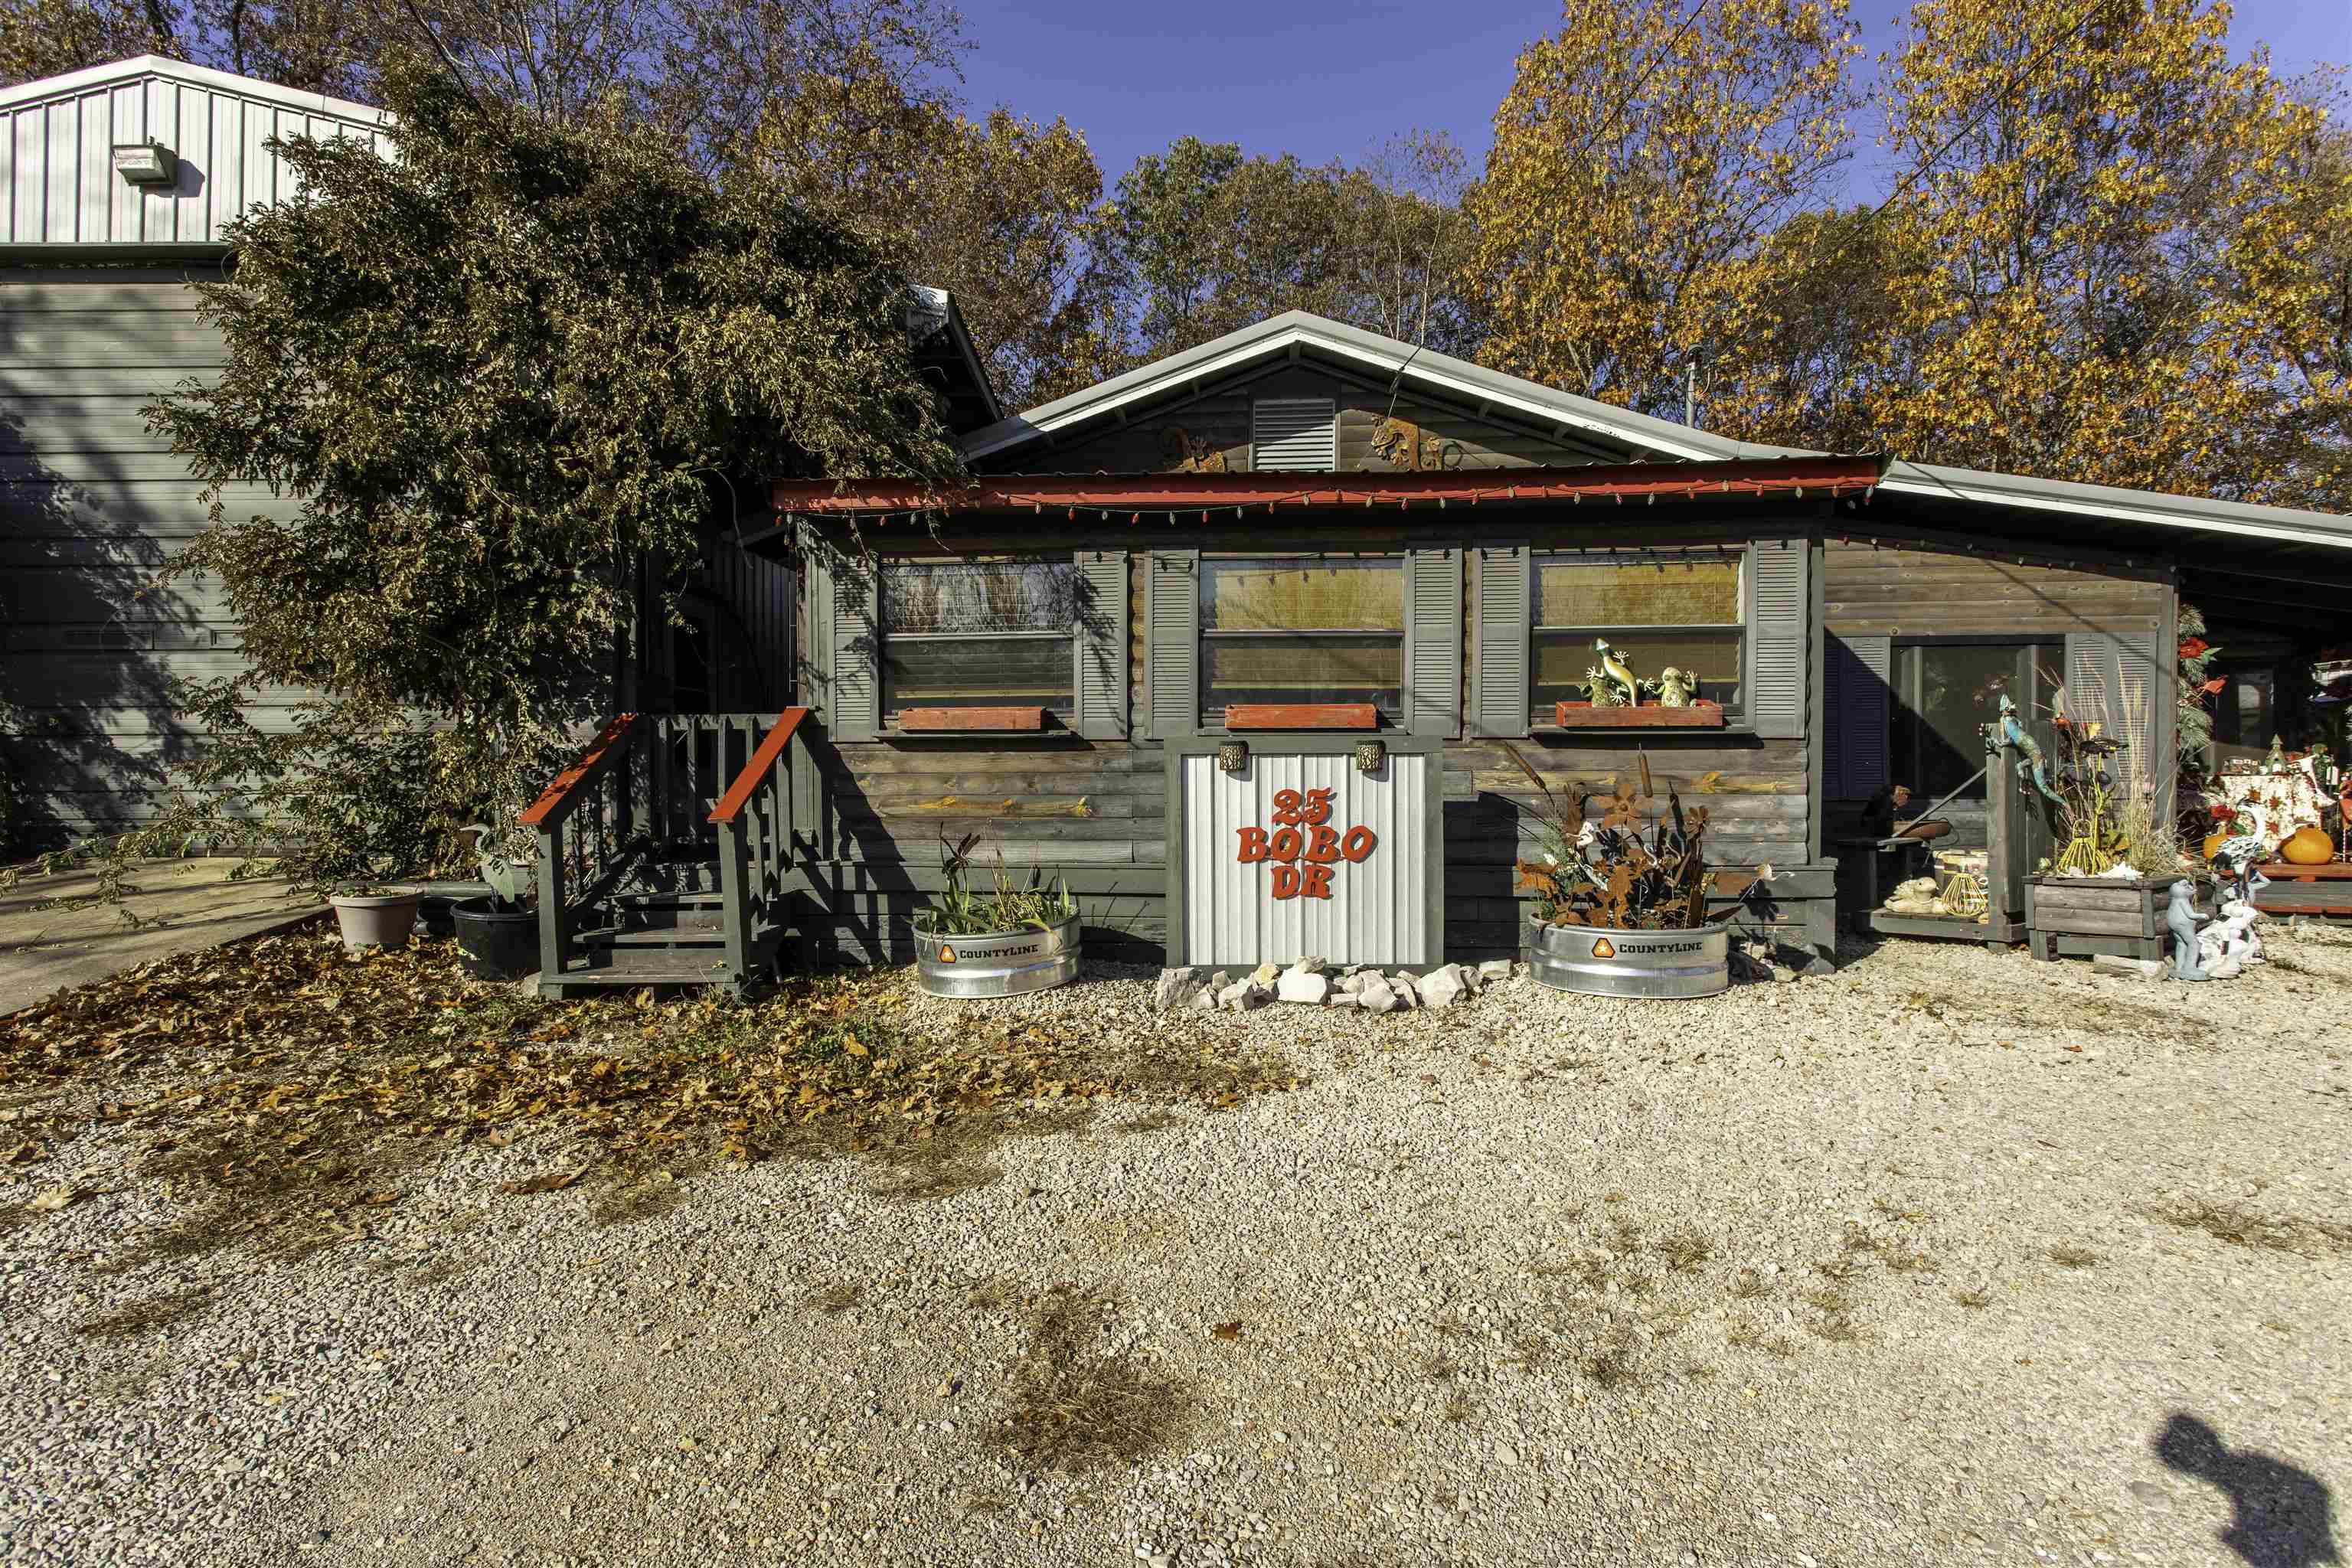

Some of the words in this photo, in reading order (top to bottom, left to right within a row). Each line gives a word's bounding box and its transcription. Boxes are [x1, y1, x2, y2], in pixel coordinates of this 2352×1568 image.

[1272, 787, 1336, 826] 25
[1236, 825, 1377, 864] BOBO
[1271, 864, 1334, 900] DR
